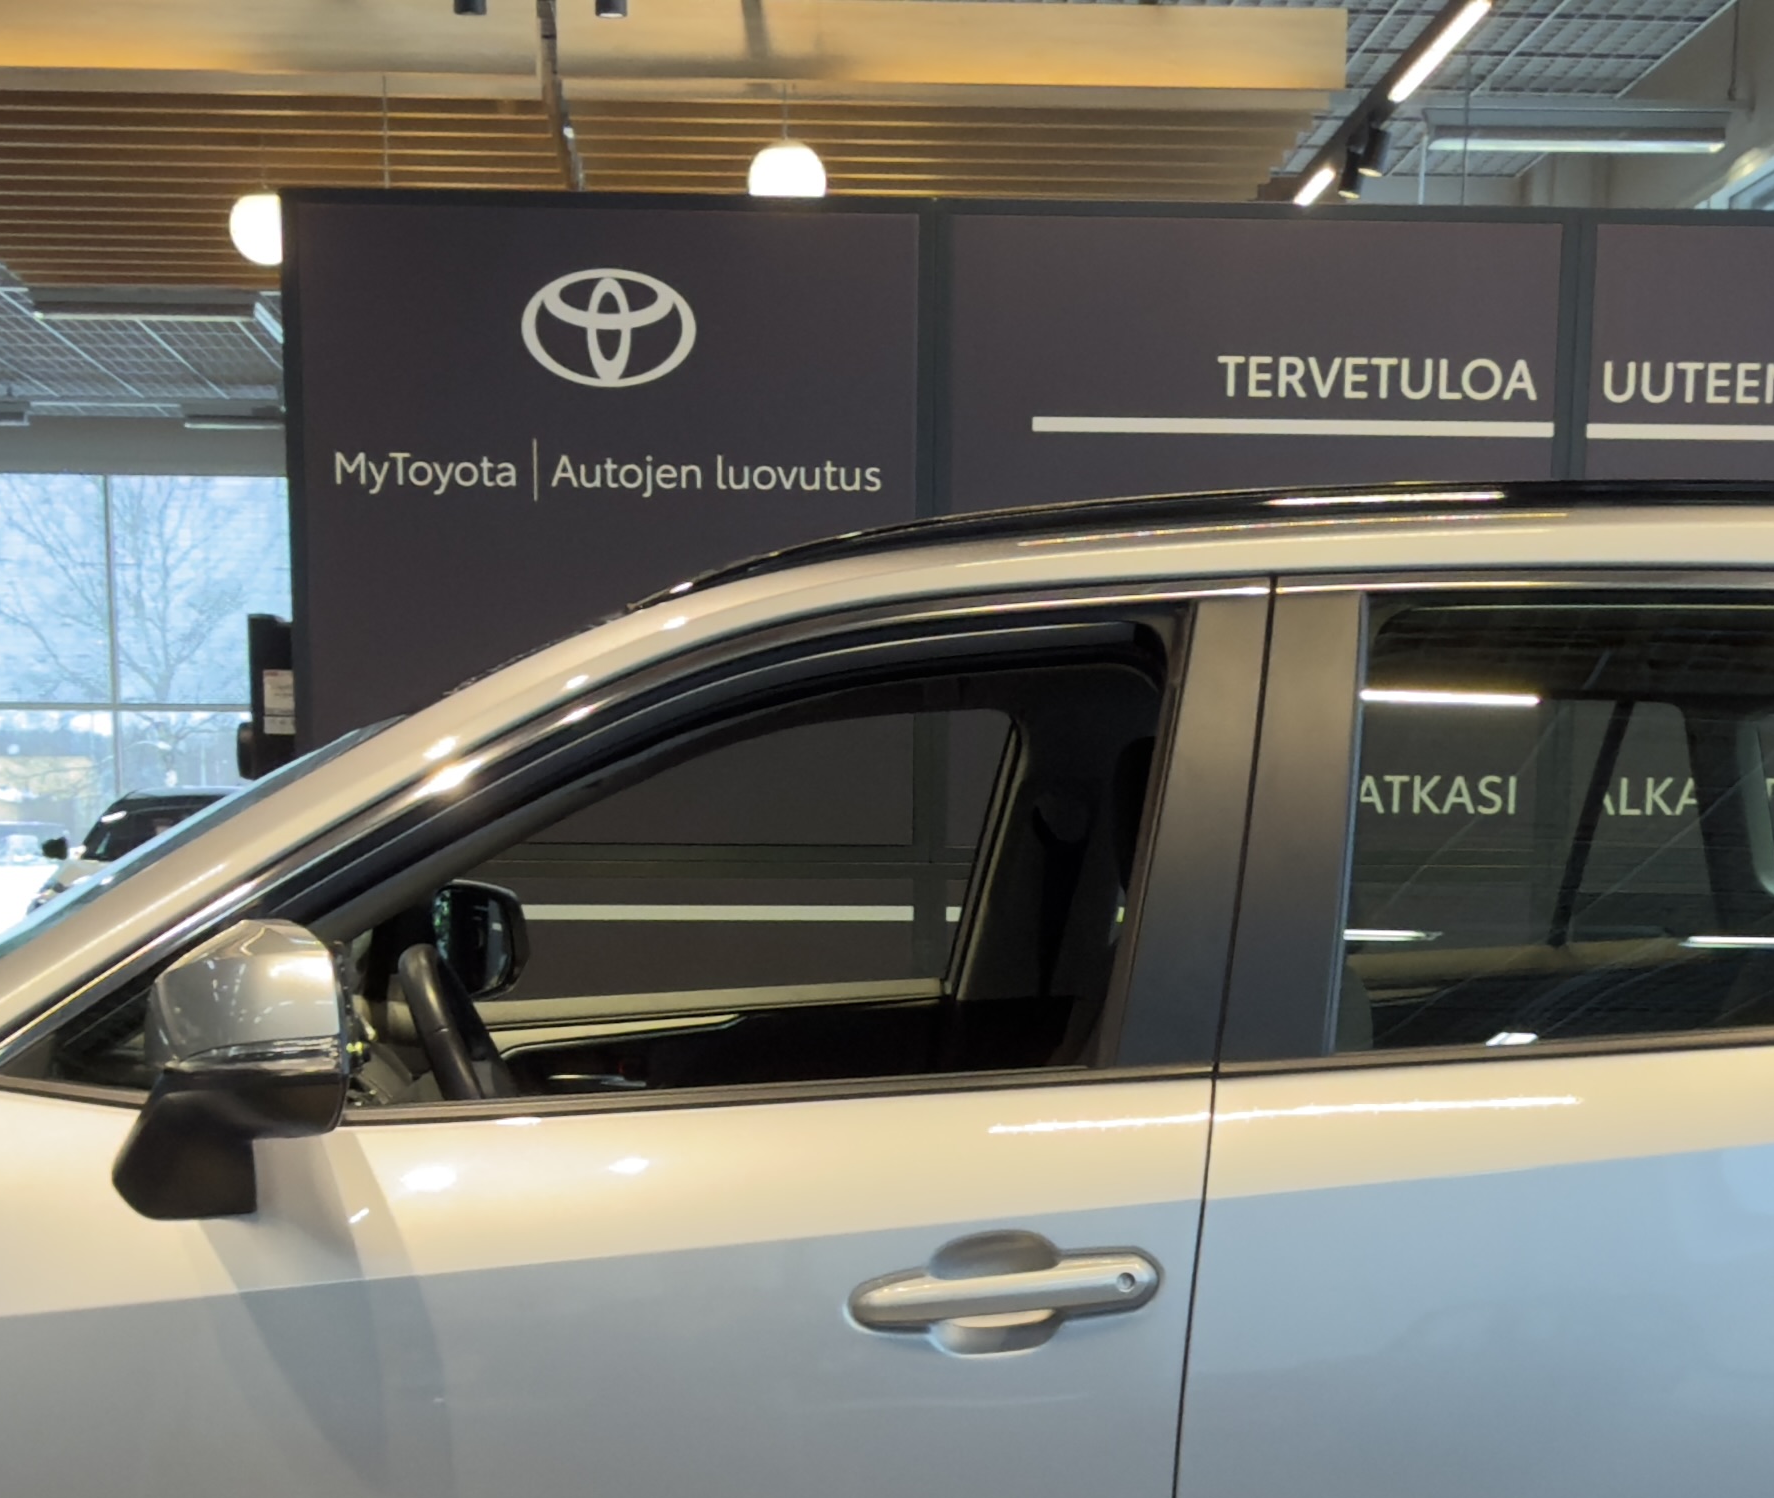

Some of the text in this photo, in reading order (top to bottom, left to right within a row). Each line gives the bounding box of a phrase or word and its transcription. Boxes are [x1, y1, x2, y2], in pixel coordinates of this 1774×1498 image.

[1218, 355, 1537, 401] TERVETULOA
[334, 451, 882, 498] MyToyota Autojen luovutus
[1359, 774, 1518, 816] ATKASI
[1603, 776, 1698, 816] LKA
